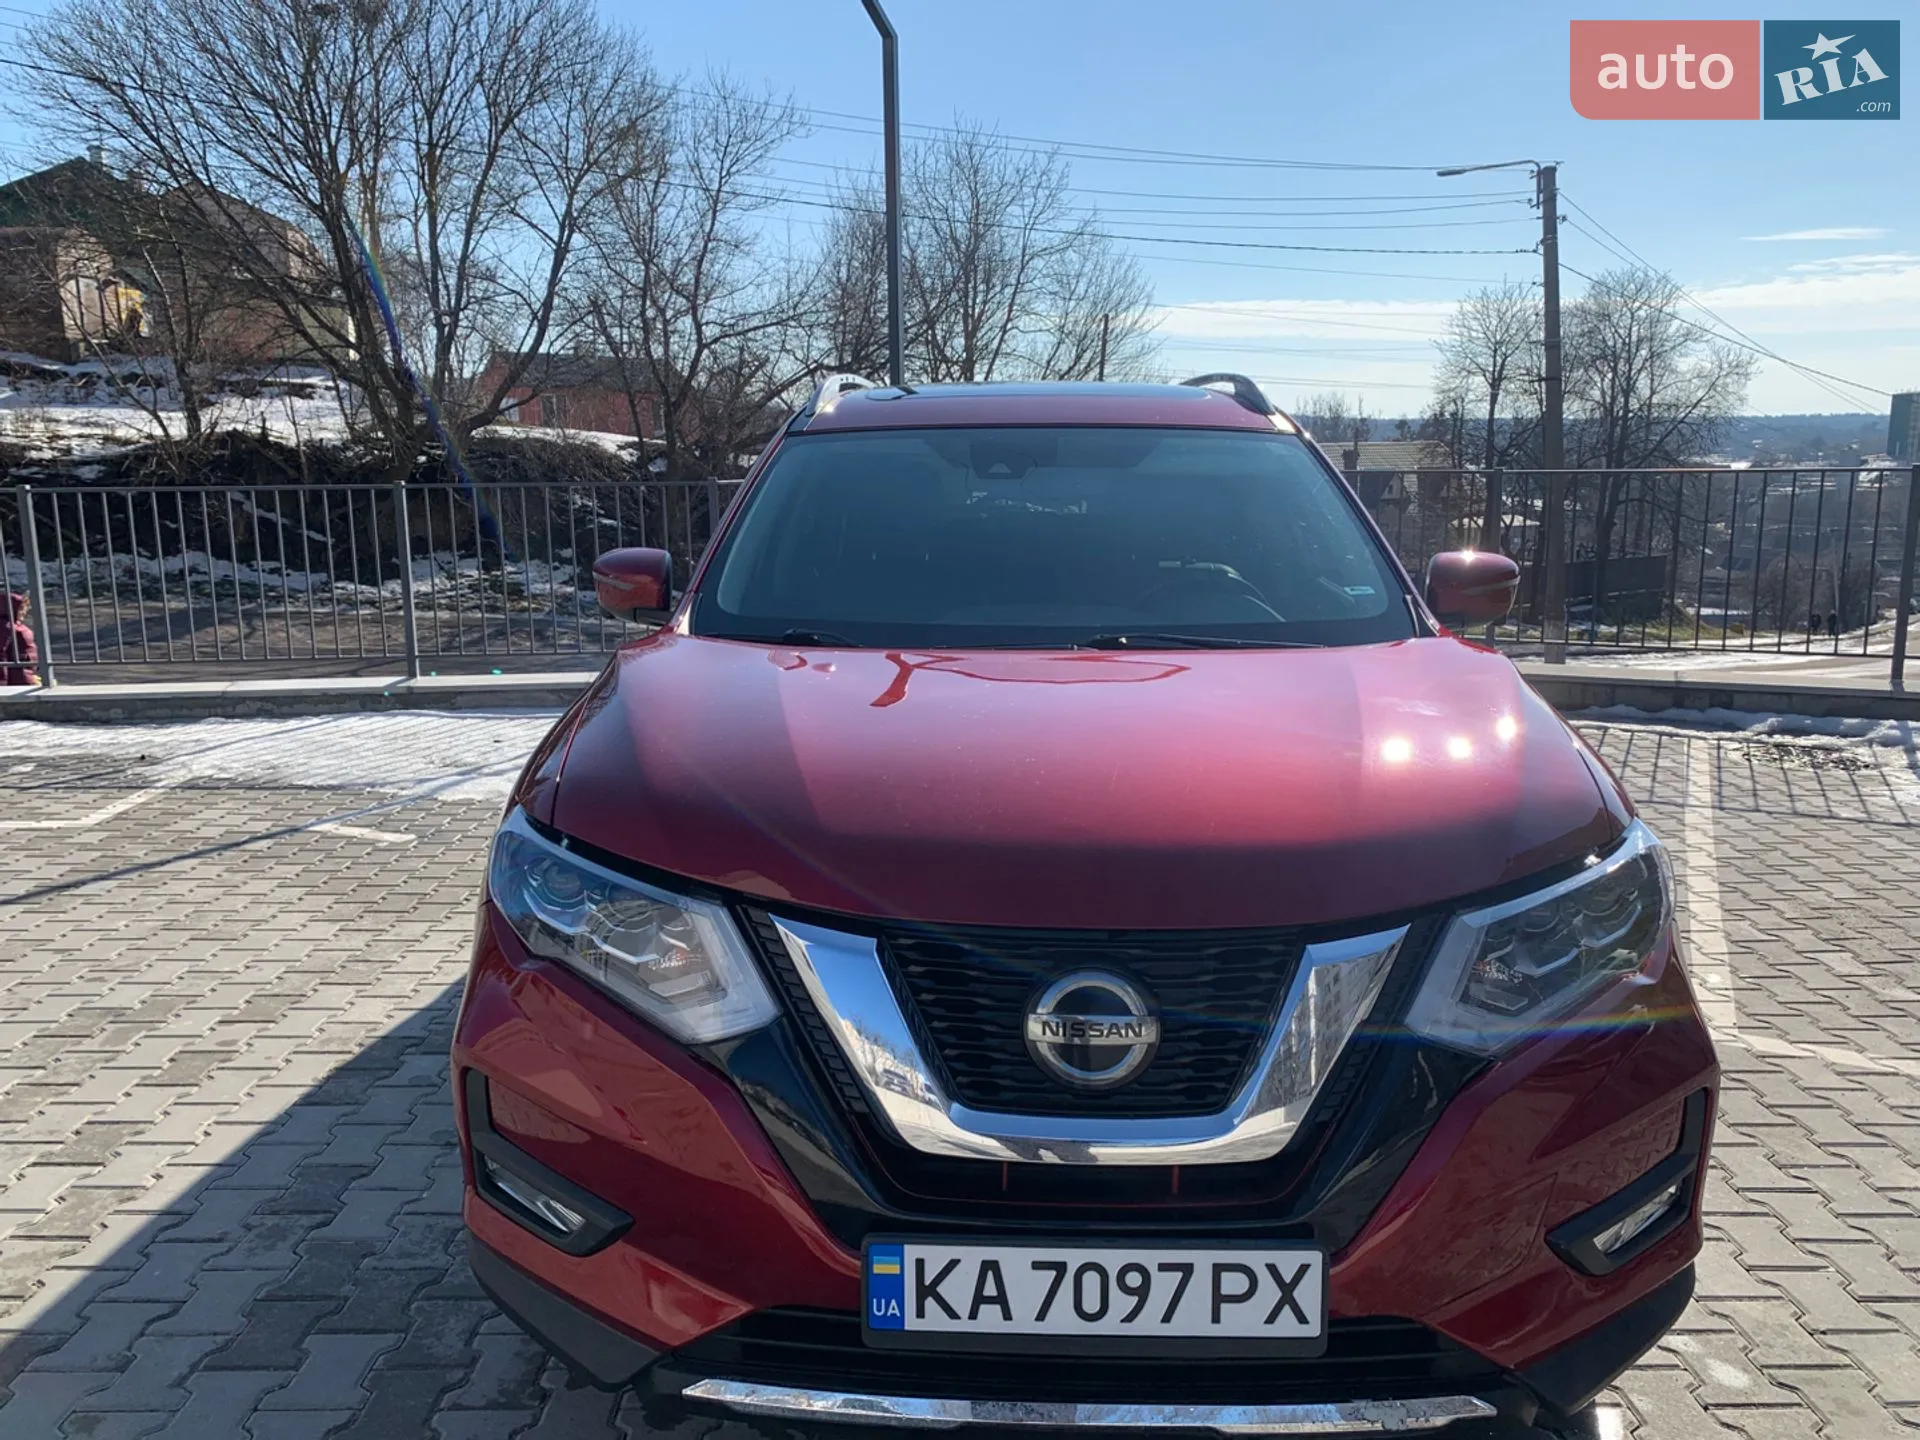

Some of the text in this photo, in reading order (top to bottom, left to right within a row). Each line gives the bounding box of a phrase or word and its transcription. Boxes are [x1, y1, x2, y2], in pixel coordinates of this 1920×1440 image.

[1041, 1021, 1143, 1038] NISSAN
[914, 1257, 1312, 1325] KA 7097 PX
[872, 1298, 901, 1318] UA
